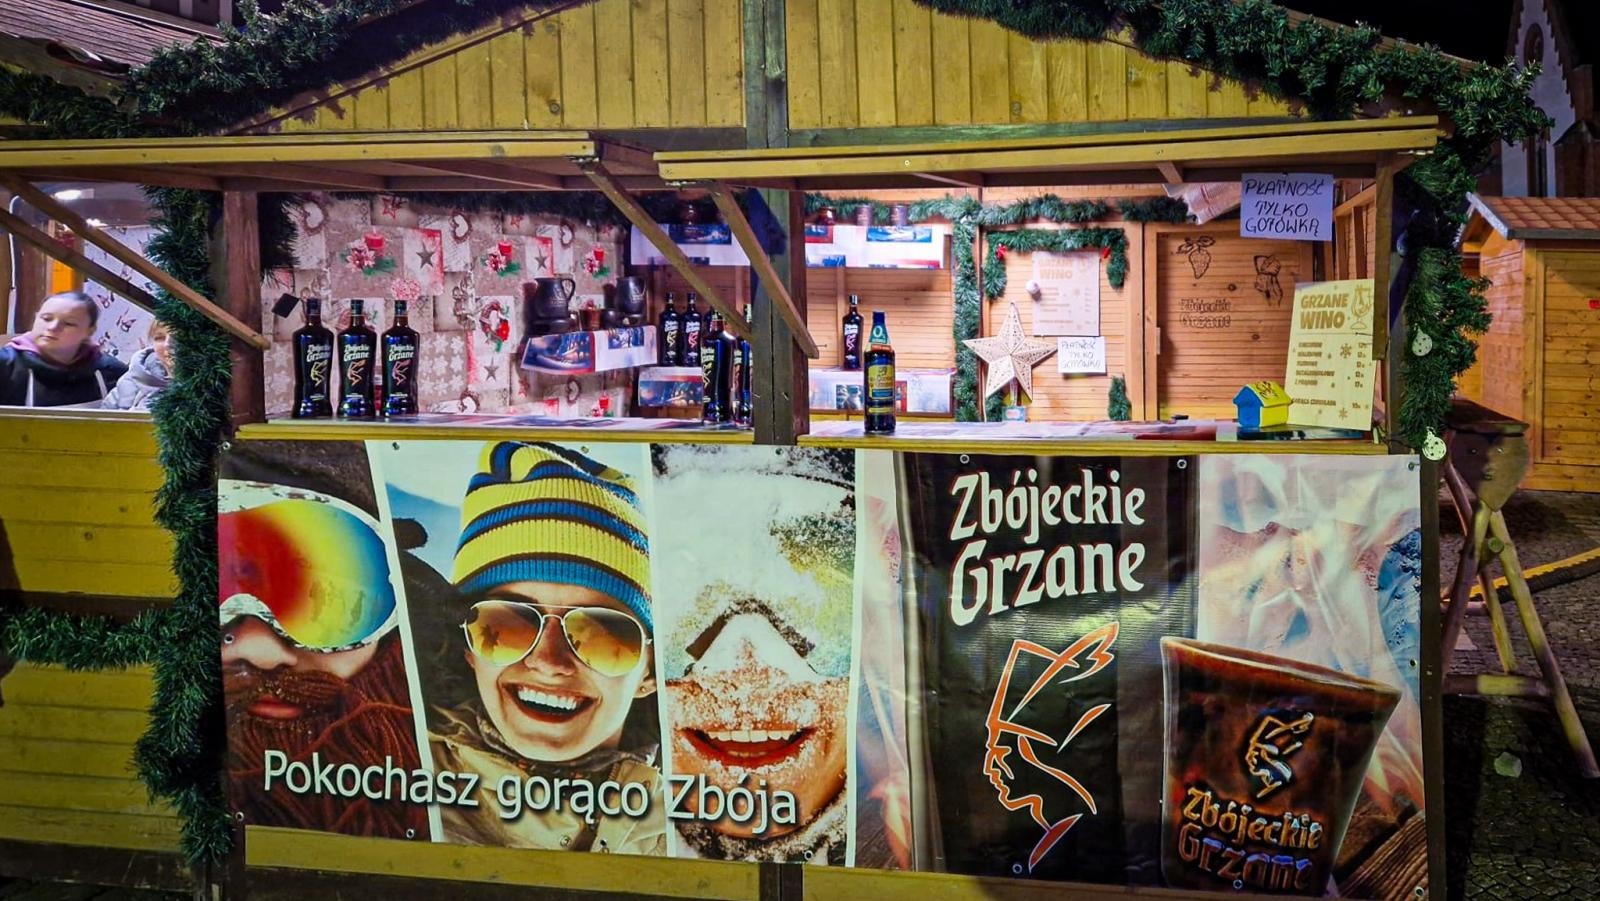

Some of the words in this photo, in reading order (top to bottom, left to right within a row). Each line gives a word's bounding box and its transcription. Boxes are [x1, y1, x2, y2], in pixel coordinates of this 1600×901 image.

[1245, 178, 1324, 196] PŁATNOŚĆ
[1245, 216, 1319, 237] GOTÓWKĄ
[1255, 200, 1308, 217] TYLKO
[1300, 310, 1345, 330] WINO
[1301, 293, 1349, 309] GRZANE
[950, 468, 1146, 544] Zbójeckie
[950, 538, 1146, 627] Grzane
[263, 749, 480, 807] Pokochasz
[496, 776, 650, 825] gorąco
[666, 773, 798, 836] Zbója
[1183, 786, 1325, 850] Zbójeckie
[1178, 822, 1314, 890] Grzane
